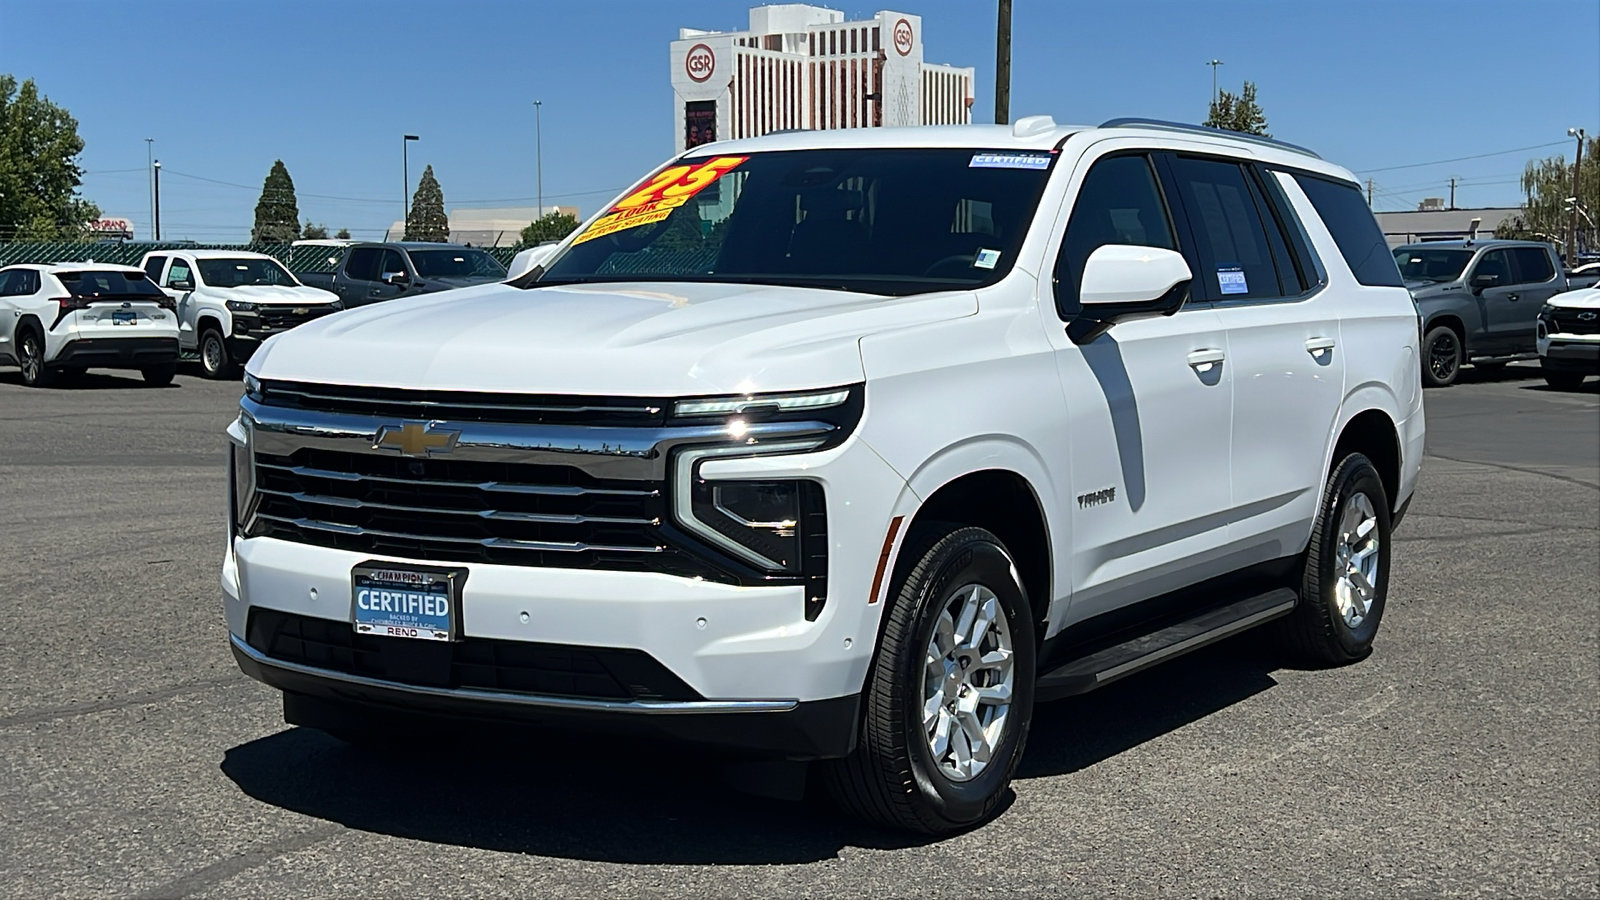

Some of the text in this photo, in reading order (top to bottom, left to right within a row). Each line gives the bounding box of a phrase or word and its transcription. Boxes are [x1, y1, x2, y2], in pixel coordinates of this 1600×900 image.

[896, 29, 911, 46] GSR
[689, 54, 711, 72] GSR
[975, 155, 1046, 165] CERTIFIED
[615, 157, 744, 208] 25
[615, 202, 660, 221] LOOK
[622, 210, 669, 228] SEATING
[101, 220, 126, 229] GRAND
[378, 571, 424, 582] CHAMPION
[358, 590, 449, 617] CERTIFIED
[387, 627, 418, 637] RENO
